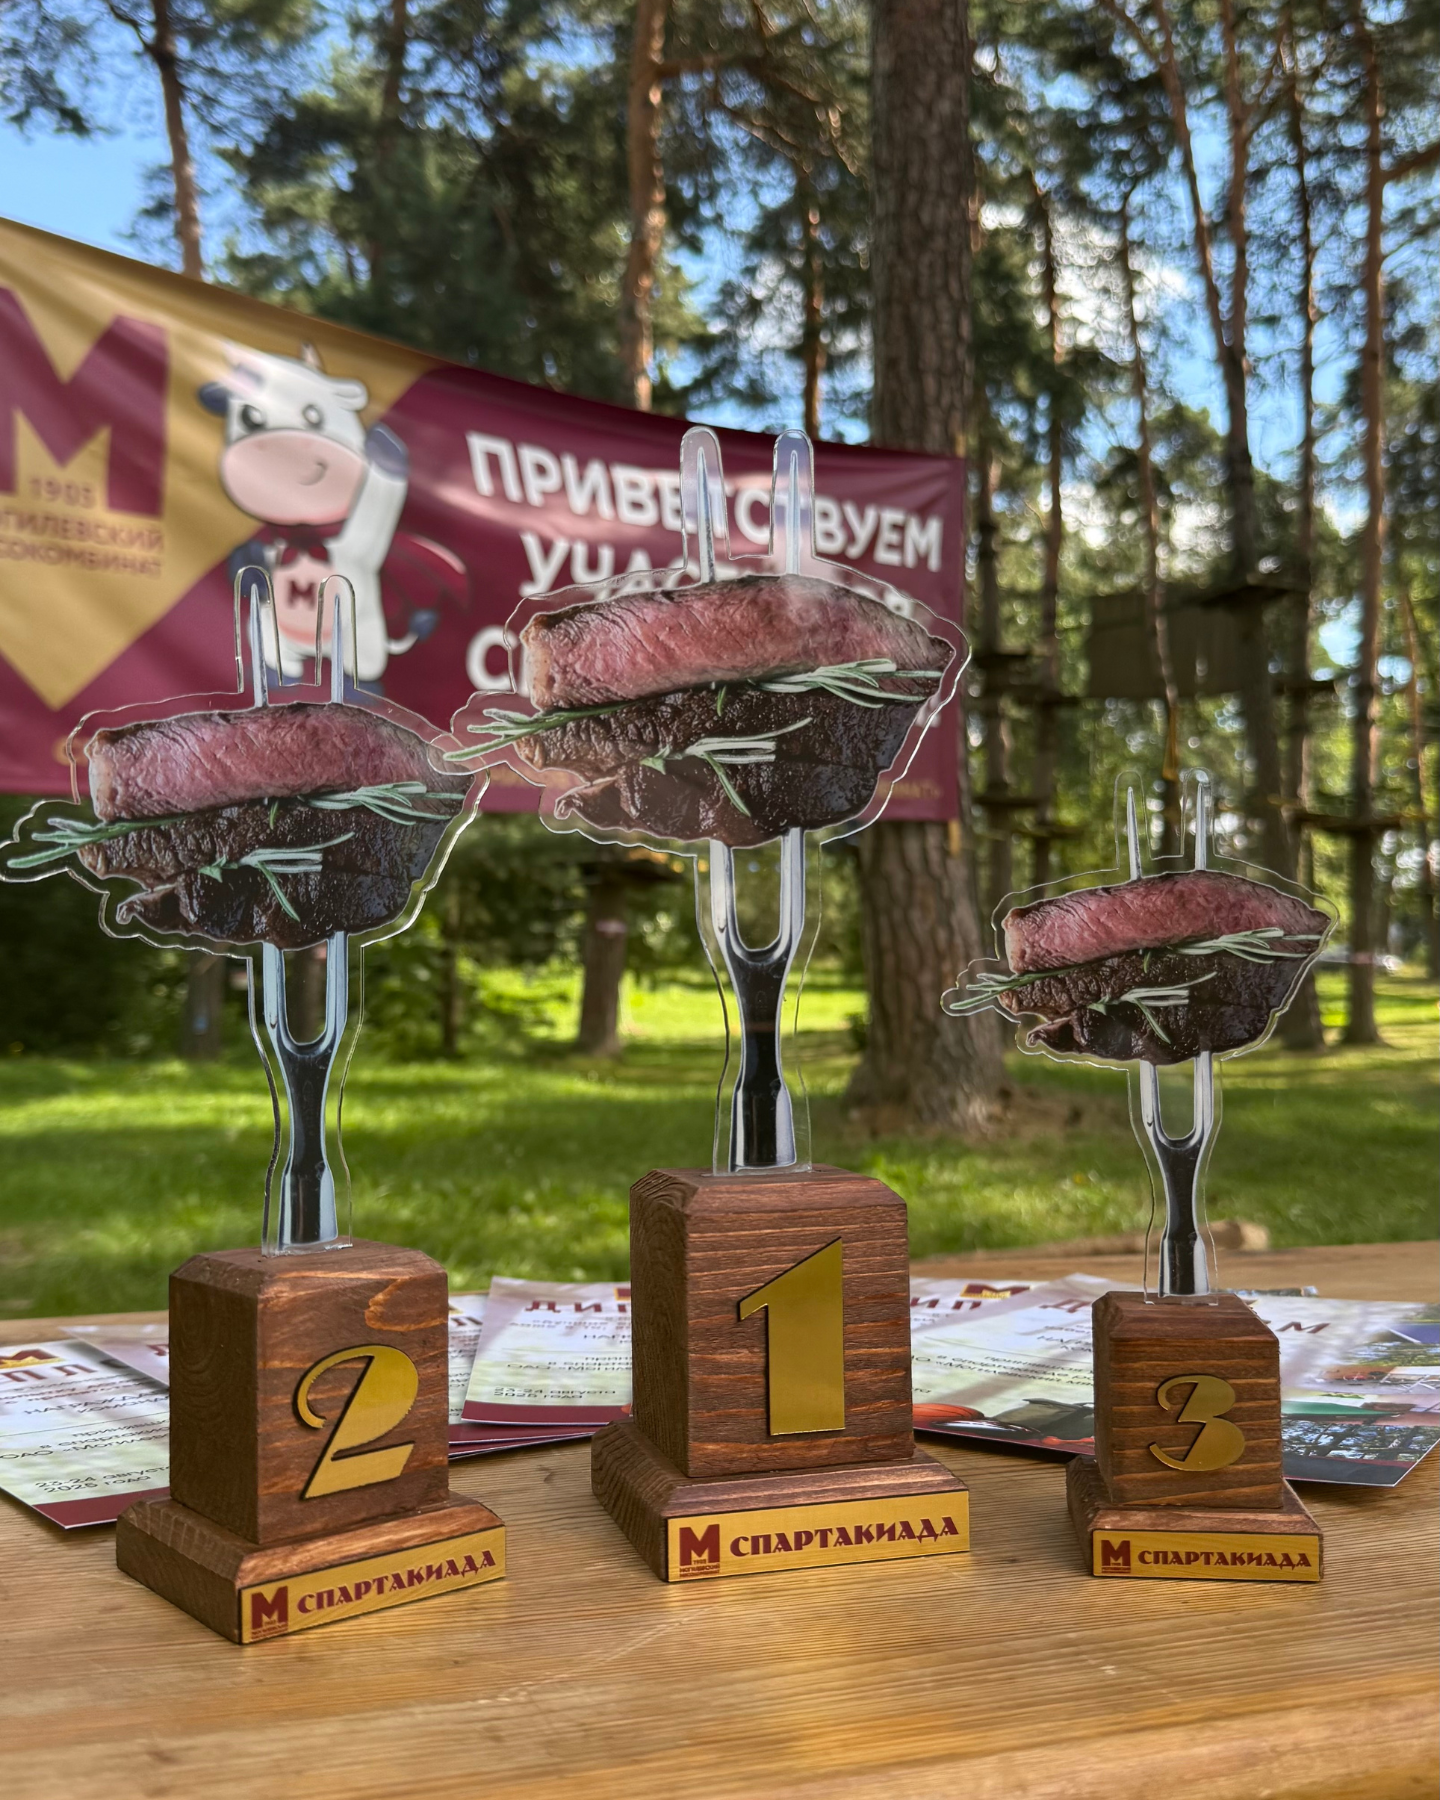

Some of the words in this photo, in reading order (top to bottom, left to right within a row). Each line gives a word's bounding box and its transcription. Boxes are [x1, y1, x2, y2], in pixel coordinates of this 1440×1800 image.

[29, 476, 97, 510] 1905
[0, 506, 165, 550] ГИЛЕВСКИЙ
[288, 577, 318, 611] М
[737, 1236, 846, 1436] 1
[293, 1343, 420, 1500] 2
[1149, 1373, 1246, 1472] 3
[678, 1523, 720, 1567] М
[730, 1516, 960, 1558] СПАРТАКИАДА
[1101, 1539, 1131, 1567] М
[1137, 1550, 1312, 1570] СПАРТАКИАДА
[251, 1585, 289, 1630] М
[296, 1550, 496, 1614] СПАРТАКИАДА
